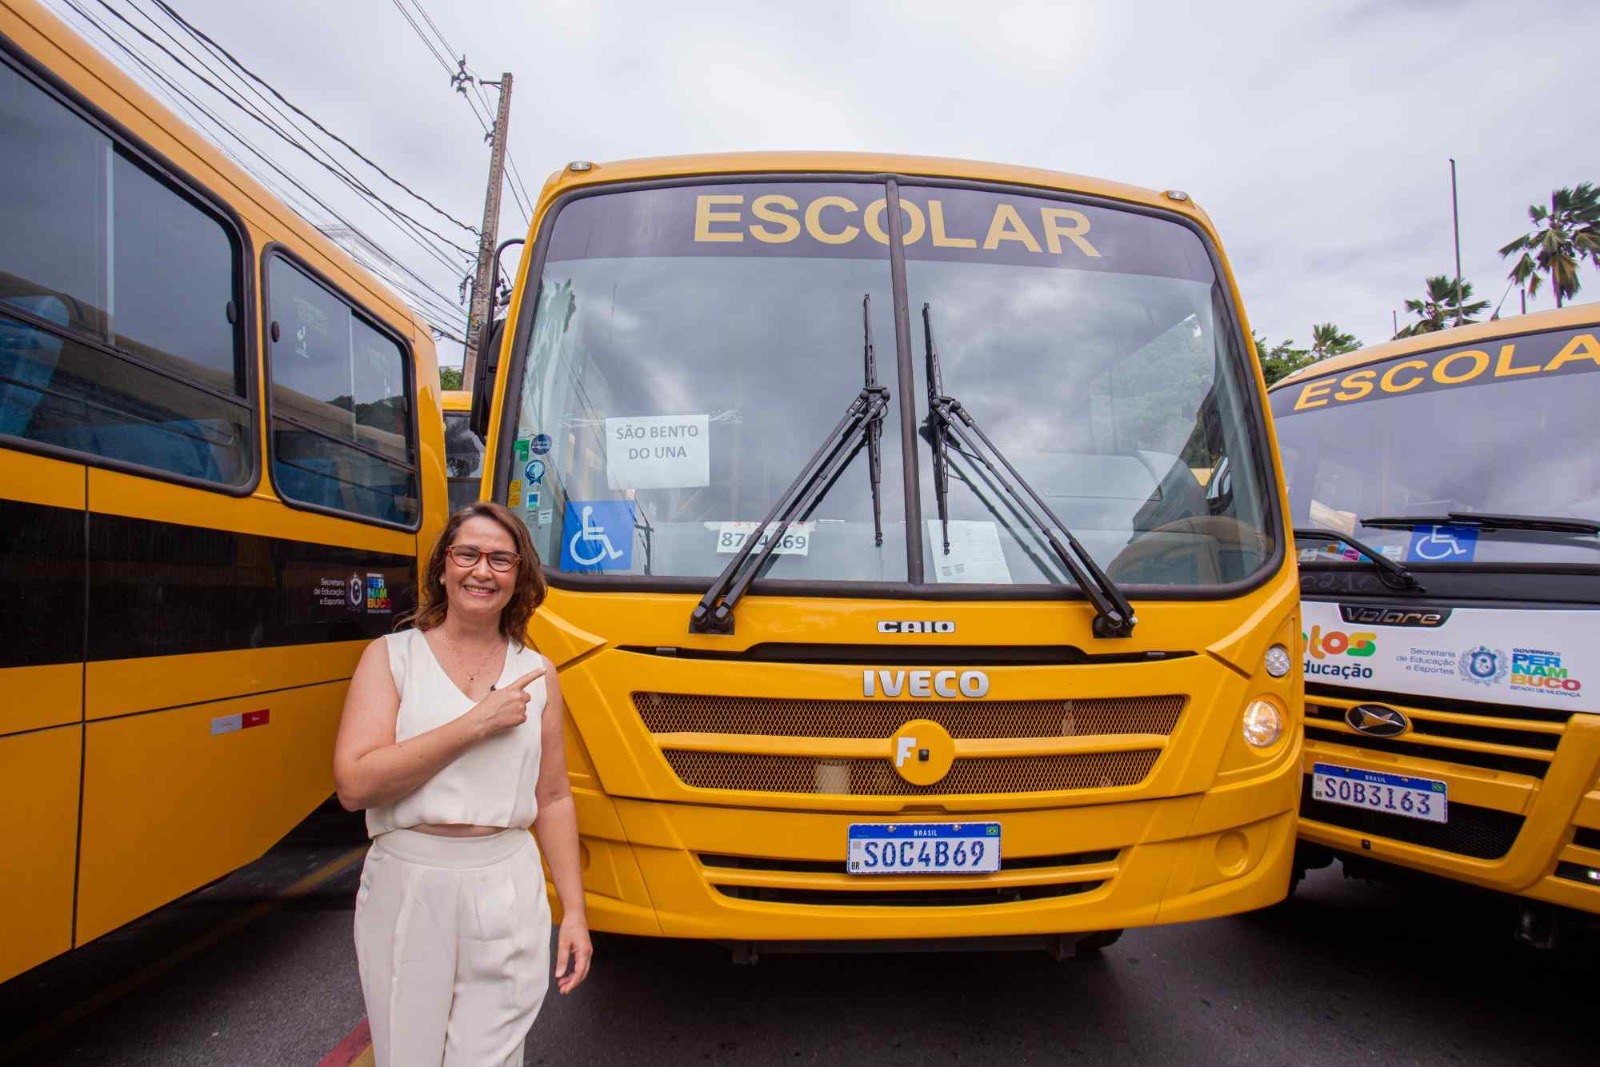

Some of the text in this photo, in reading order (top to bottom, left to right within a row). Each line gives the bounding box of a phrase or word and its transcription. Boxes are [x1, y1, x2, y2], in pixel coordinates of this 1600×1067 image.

[694, 194, 1101, 257] ESCOLAR
[1294, 333, 1600, 411] ESCOLA
[616, 425, 699, 440] SÃO BENTO
[629, 446, 687, 460] DO UNA
[721, 532, 806, 549] 87469
[1346, 607, 1441, 625] Volare
[877, 621, 955, 633] CAIO
[1410, 648, 1456, 658] Secretaria
[1512, 653, 1561, 668] PER
[1410, 656, 1455, 667] Educação
[1414, 665, 1454, 675] Esportes
[1512, 663, 1568, 678] NAM
[863, 670, 989, 697] IVECO
[1510, 675, 1581, 691] BUCO
[1365, 774, 1386, 784] BRASIL
[1325, 778, 1430, 815] SOB3163
[914, 829, 938, 837] BRASIL
[864, 841, 985, 867] SOC4B69
[851, 861, 860, 870] BR
